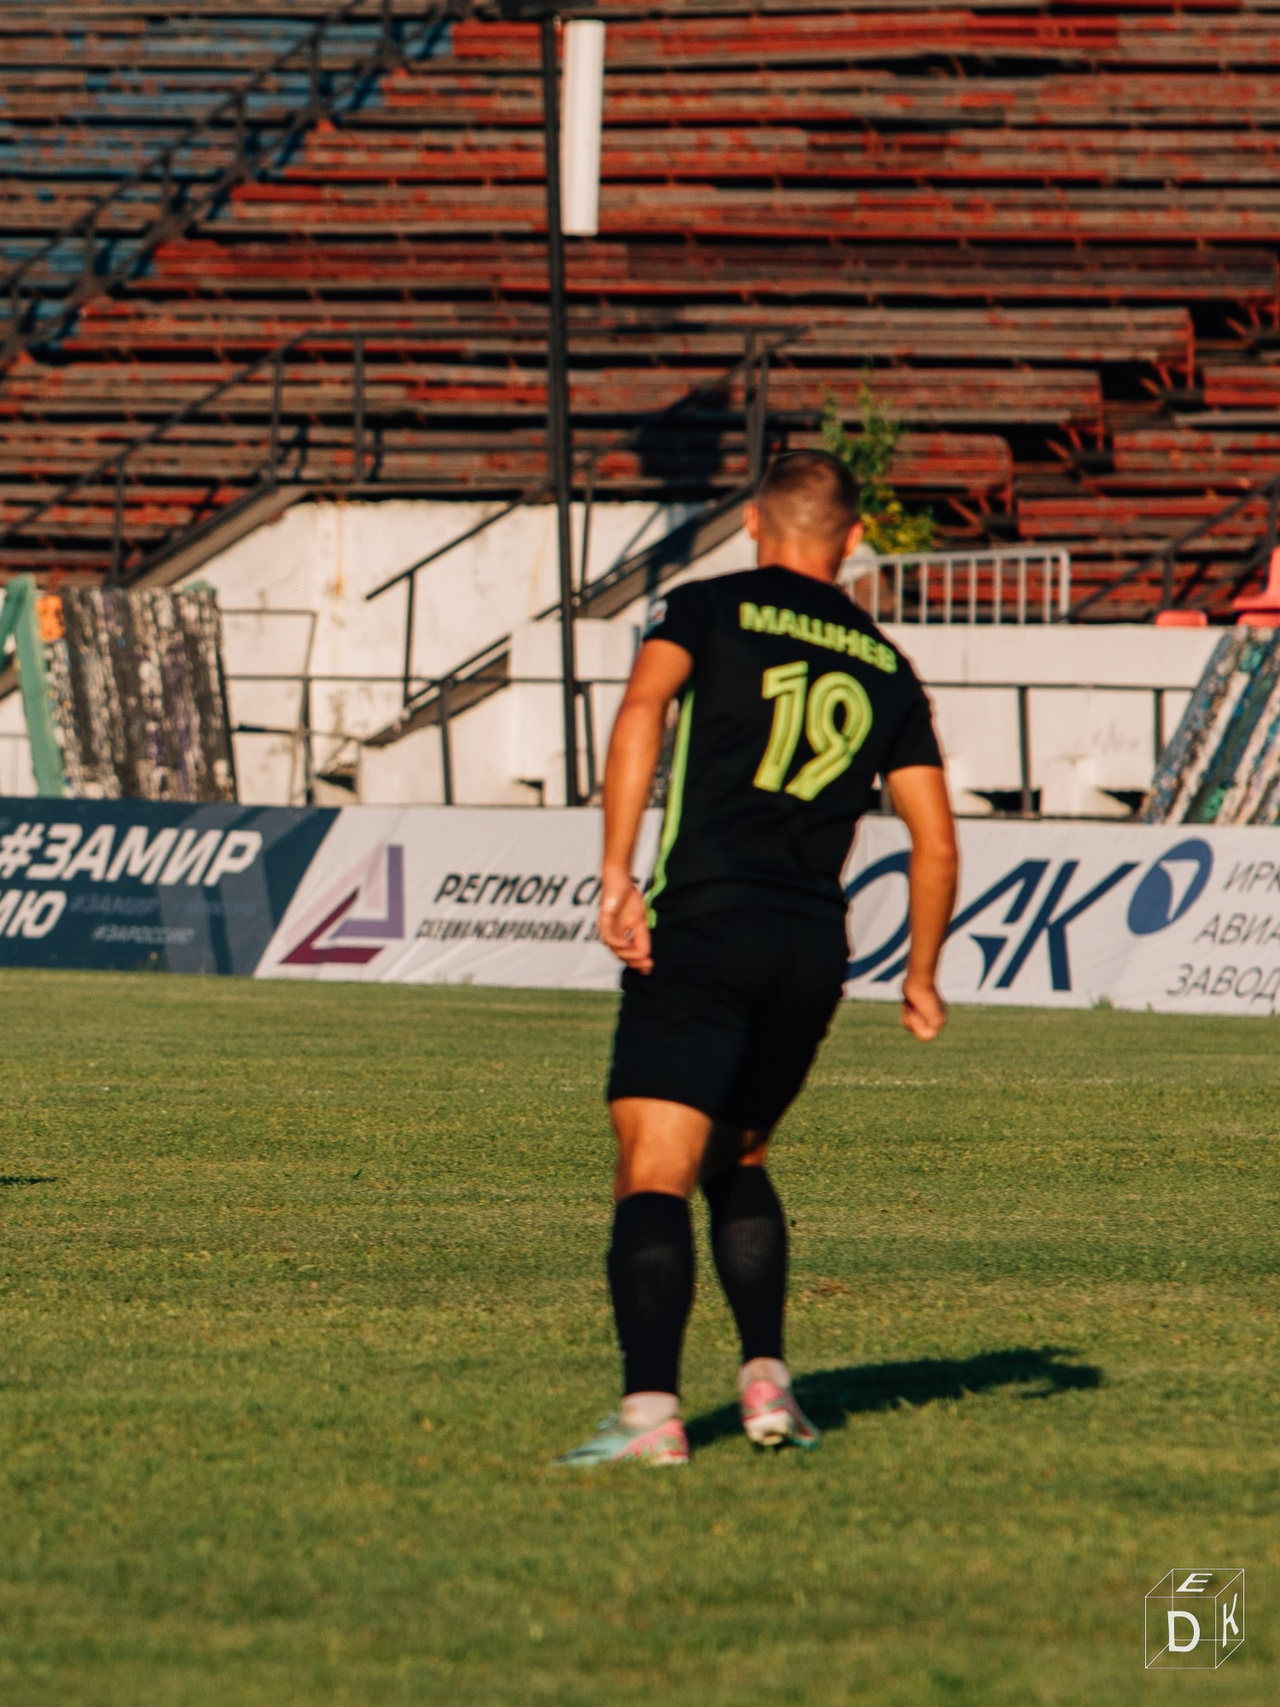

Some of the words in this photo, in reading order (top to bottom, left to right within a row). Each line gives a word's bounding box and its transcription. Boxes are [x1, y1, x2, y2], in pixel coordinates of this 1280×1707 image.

[739, 601, 897, 674] МАШНЕВ
[753, 660, 873, 801] 19
[433, 873, 568, 906] РЕГИОН
